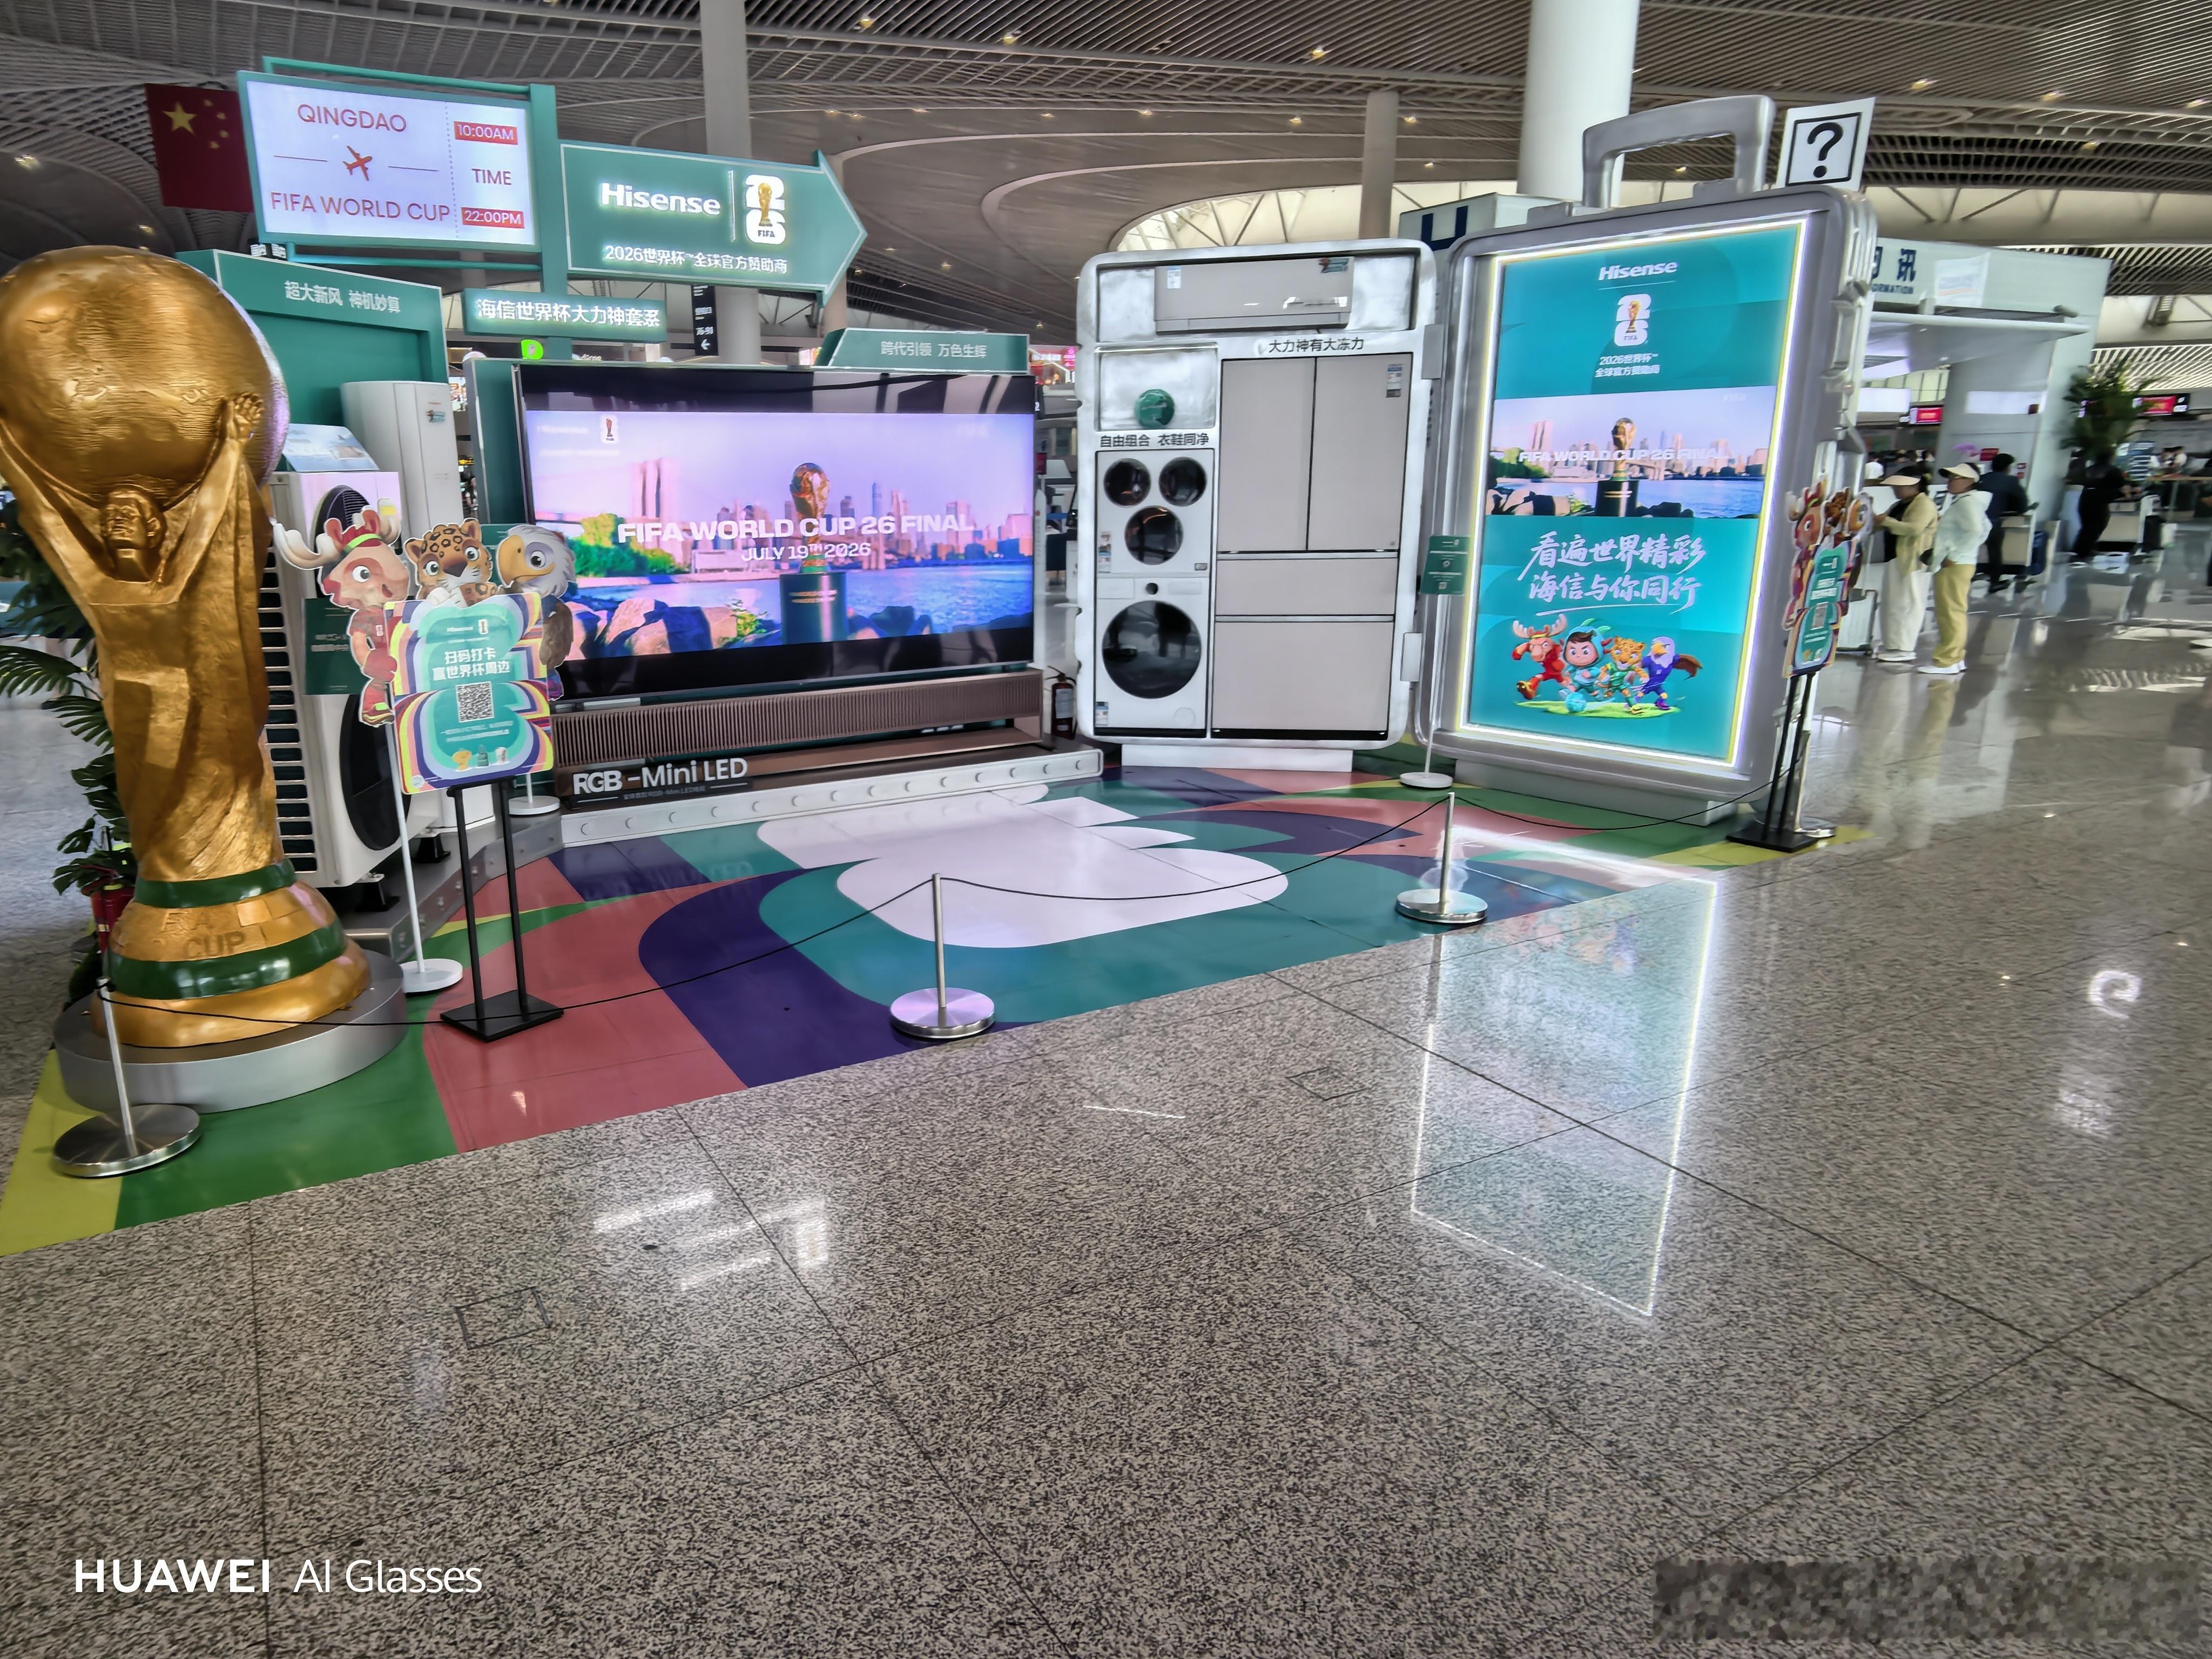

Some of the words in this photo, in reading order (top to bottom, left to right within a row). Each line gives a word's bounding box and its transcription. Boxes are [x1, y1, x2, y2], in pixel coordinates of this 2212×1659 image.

[297, 104, 407, 132] QINGDAO
[457, 124, 514, 141] 10:00AM
[471, 168, 512, 186] TIME
[271, 192, 315, 213] FIFA
[320, 195, 401, 219] WORLD
[407, 203, 450, 222] CUP
[601, 182, 721, 215] Hisense
[464, 210, 521, 225] 22:00PM
[758, 230, 775, 238] FIFA
[1599, 262, 1678, 280] Hisense
[285, 280, 343, 306] 超大新风
[348, 290, 401, 314] 神机妙算
[475, 298, 660, 328] 海信世界杯大力神套系
[881, 341, 932, 356] 跨代引领
[938, 343, 987, 358] 万色生辉
[1269, 337, 1364, 353] 大力神有大冻力
[1100, 434, 1151, 448] 自由组合
[1157, 433, 1210, 447] 衣鞋同净
[1519, 451, 1550, 462] FIFA
[1554, 450, 1610, 462] WORLD
[1614, 449, 1650, 460] CUP
[1651, 449, 1675, 460] 26
[1677, 448, 1729, 460] FINAL
[618, 522, 684, 543] FIFA
[689, 519, 794, 540] WORLD
[800, 517, 857, 537] CUP
[861, 516, 896, 535] 26
[901, 514, 974, 533] FINAL
[741, 547, 786, 562] JULY
[824, 542, 872, 558] 2026
[1518, 531, 1707, 581] 看遍世界精彩
[1529, 570, 1702, 614] 海信与你同行
[444, 646, 496, 665] 扫码打卡
[704, 757, 748, 781] LED
[183, 931, 245, 958] CUP
